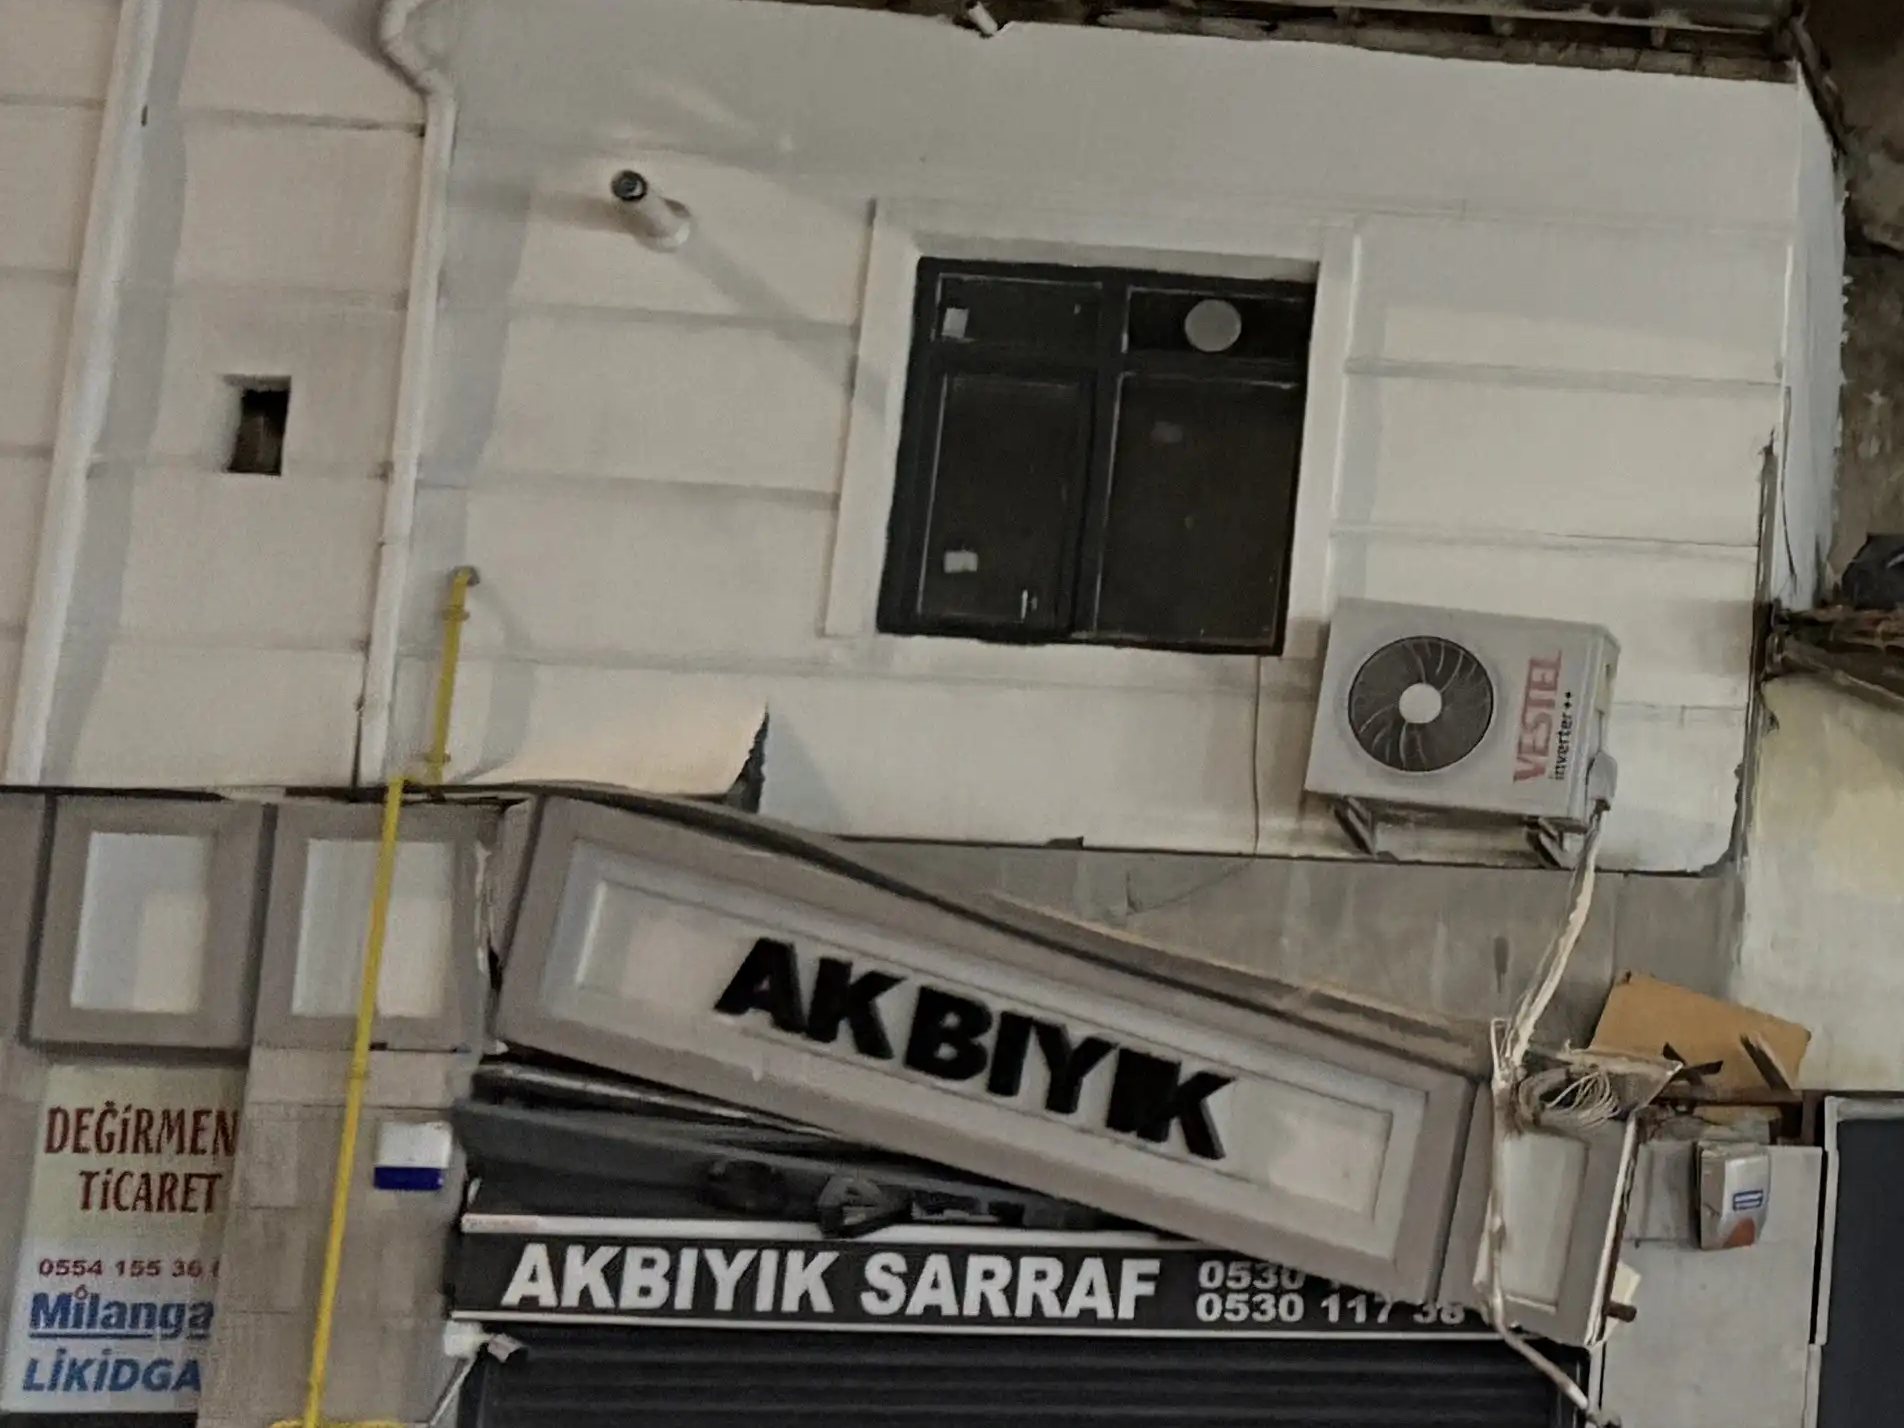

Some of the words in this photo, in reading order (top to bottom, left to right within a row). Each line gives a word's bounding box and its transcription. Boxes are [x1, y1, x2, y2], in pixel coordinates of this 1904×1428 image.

[1513, 649, 1562, 784] VESTEL
[714, 936, 1236, 1160] AKBIYIK
[45, 1100, 239, 1156] DEĞİRMEN
[78, 1167, 223, 1214] TİCARET
[39, 1258, 103, 1277] 0554
[115, 1259, 161, 1278] 155
[500, 1243, 838, 1313] AKBIYIK
[860, 1253, 1161, 1321] SARRAF
[1198, 1260, 1305, 1290] 0530
[29, 1289, 214, 1338] Milanga
[1196, 1292, 1304, 1323] 0530
[1320, 1292, 1394, 1323] 117
